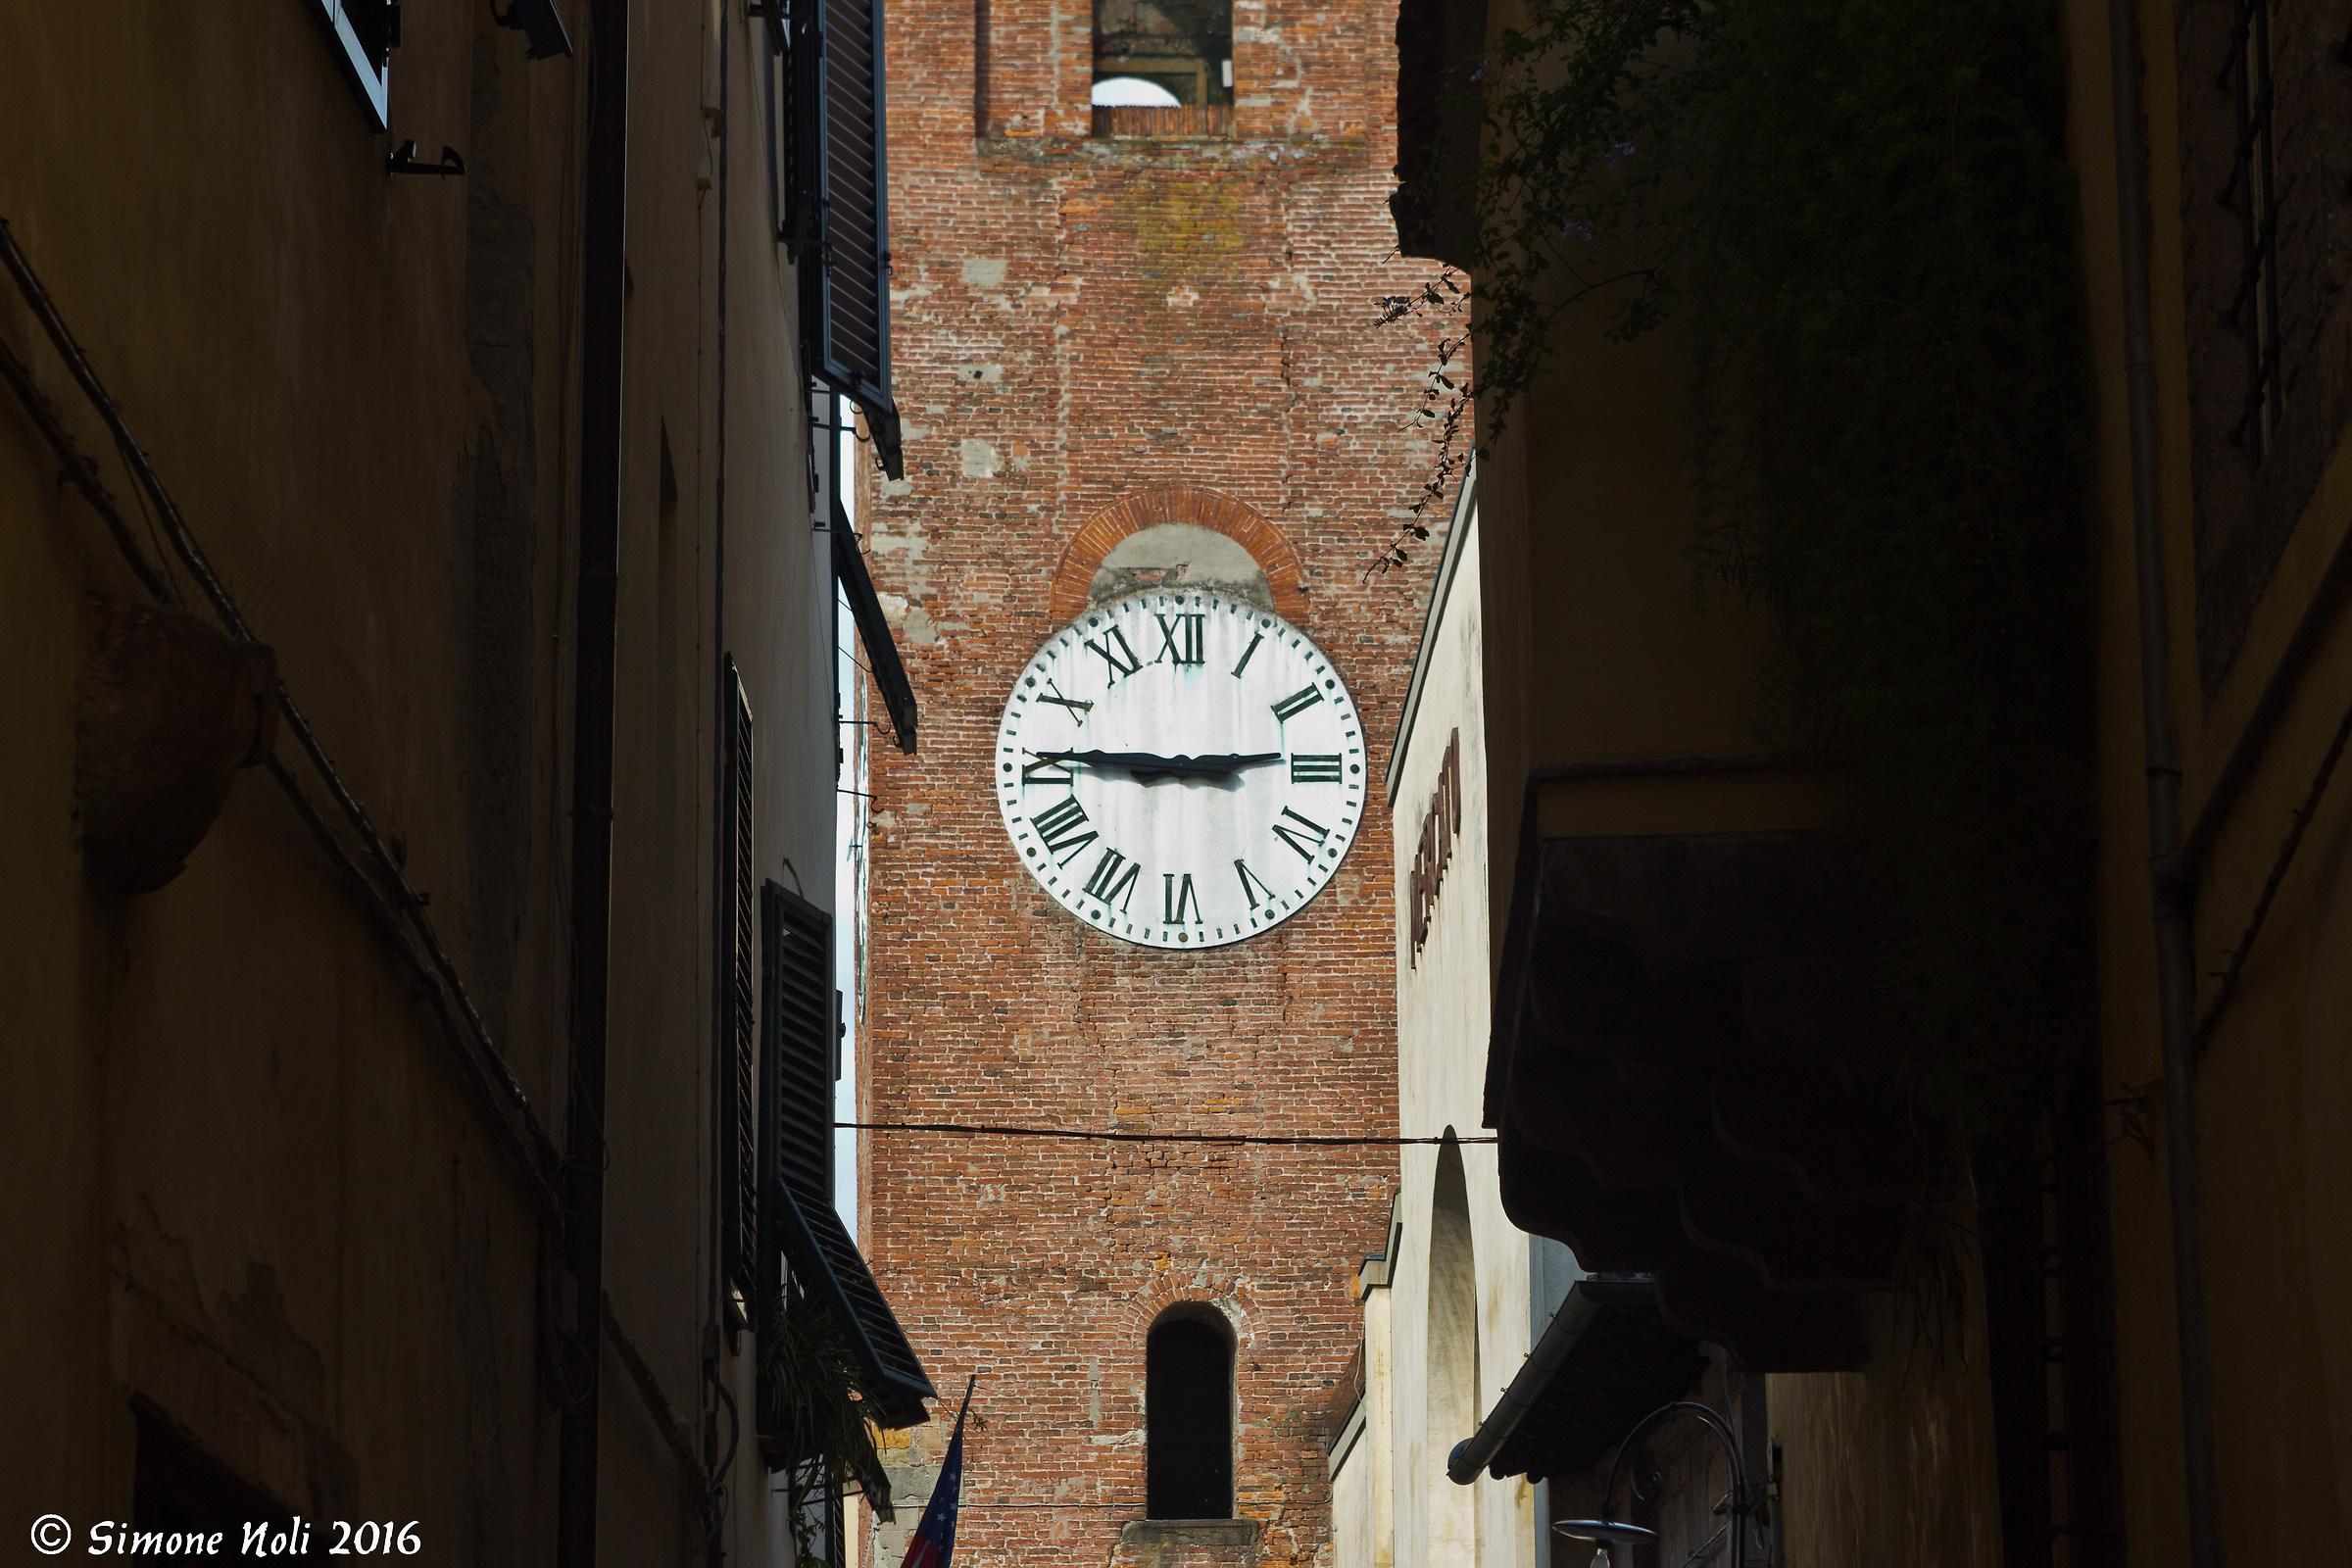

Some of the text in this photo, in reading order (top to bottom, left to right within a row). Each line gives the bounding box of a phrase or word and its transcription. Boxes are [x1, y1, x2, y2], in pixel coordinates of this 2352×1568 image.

[1085, 624, 1143, 689] XI
[1154, 613, 1204, 664] XII
[1231, 632, 1264, 678] I
[1036, 678, 1094, 727] X
[1271, 682, 1324, 724] II
[1291, 753, 1343, 784] III
[1030, 795, 1100, 869] VIII
[1272, 806, 1330, 864] IV
[1083, 847, 1141, 914] VII
[1163, 873, 1202, 925] VI
[1234, 858, 1275, 910] V
